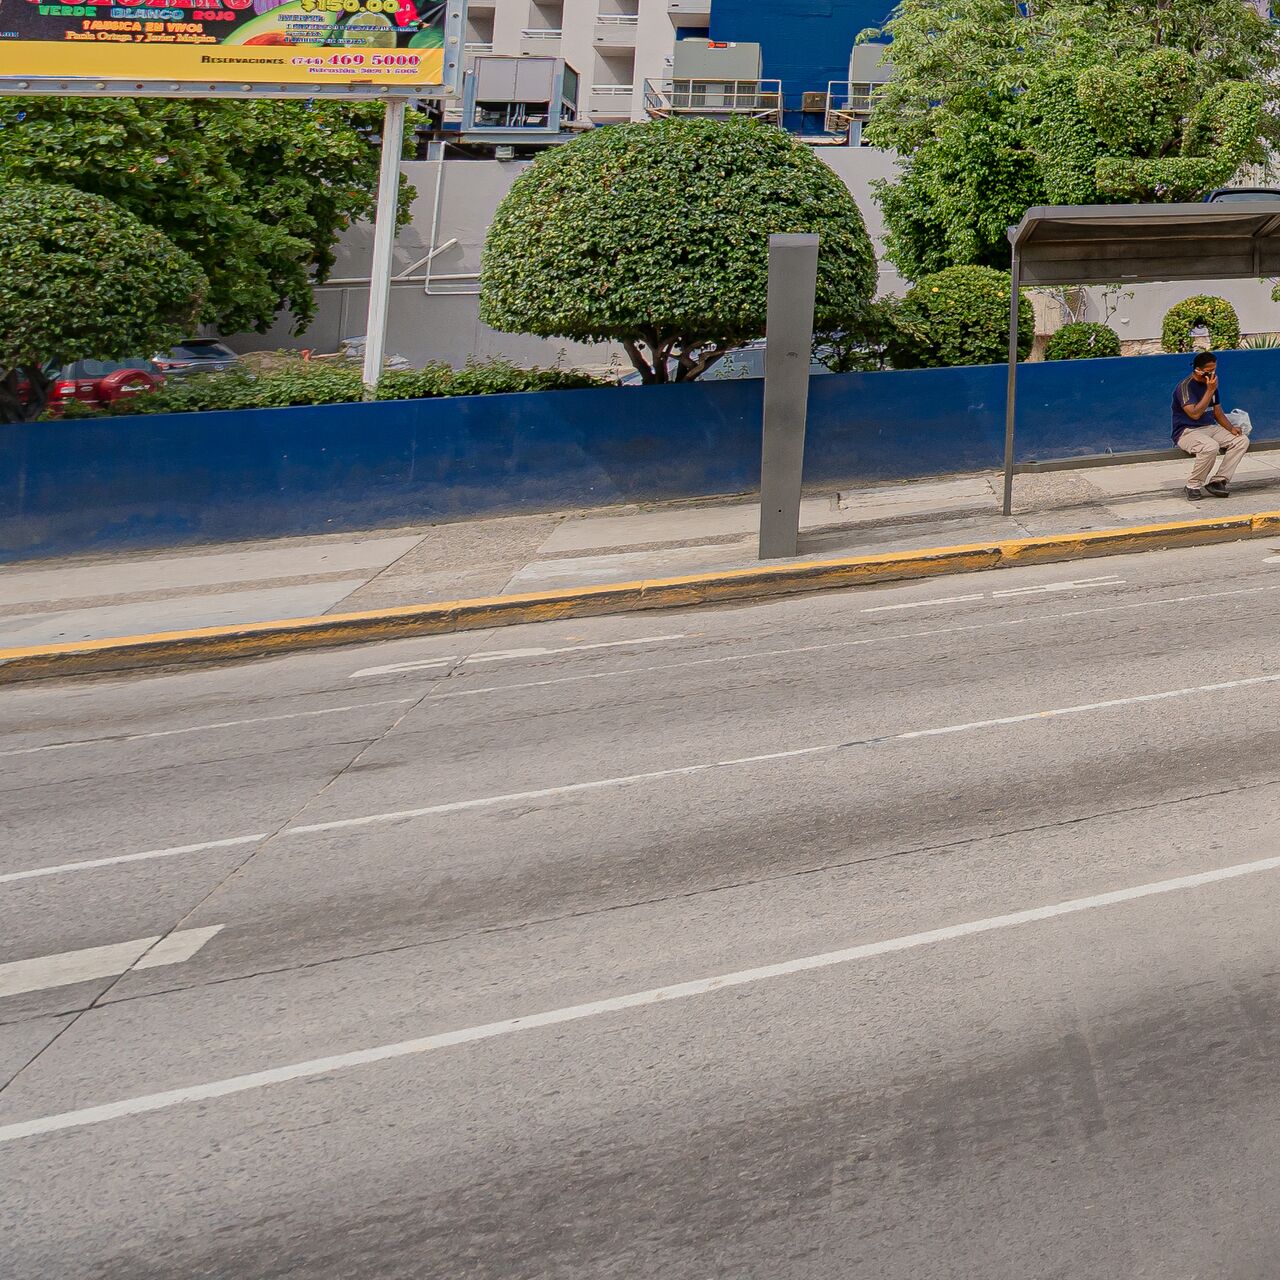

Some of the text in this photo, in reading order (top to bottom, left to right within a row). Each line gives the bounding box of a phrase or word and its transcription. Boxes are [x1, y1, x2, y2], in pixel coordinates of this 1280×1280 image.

[38, 5, 236, 21] VERDE BLANCO ROJO
[327, 54, 365, 66] 469
[371, 54, 421, 66] 5000
